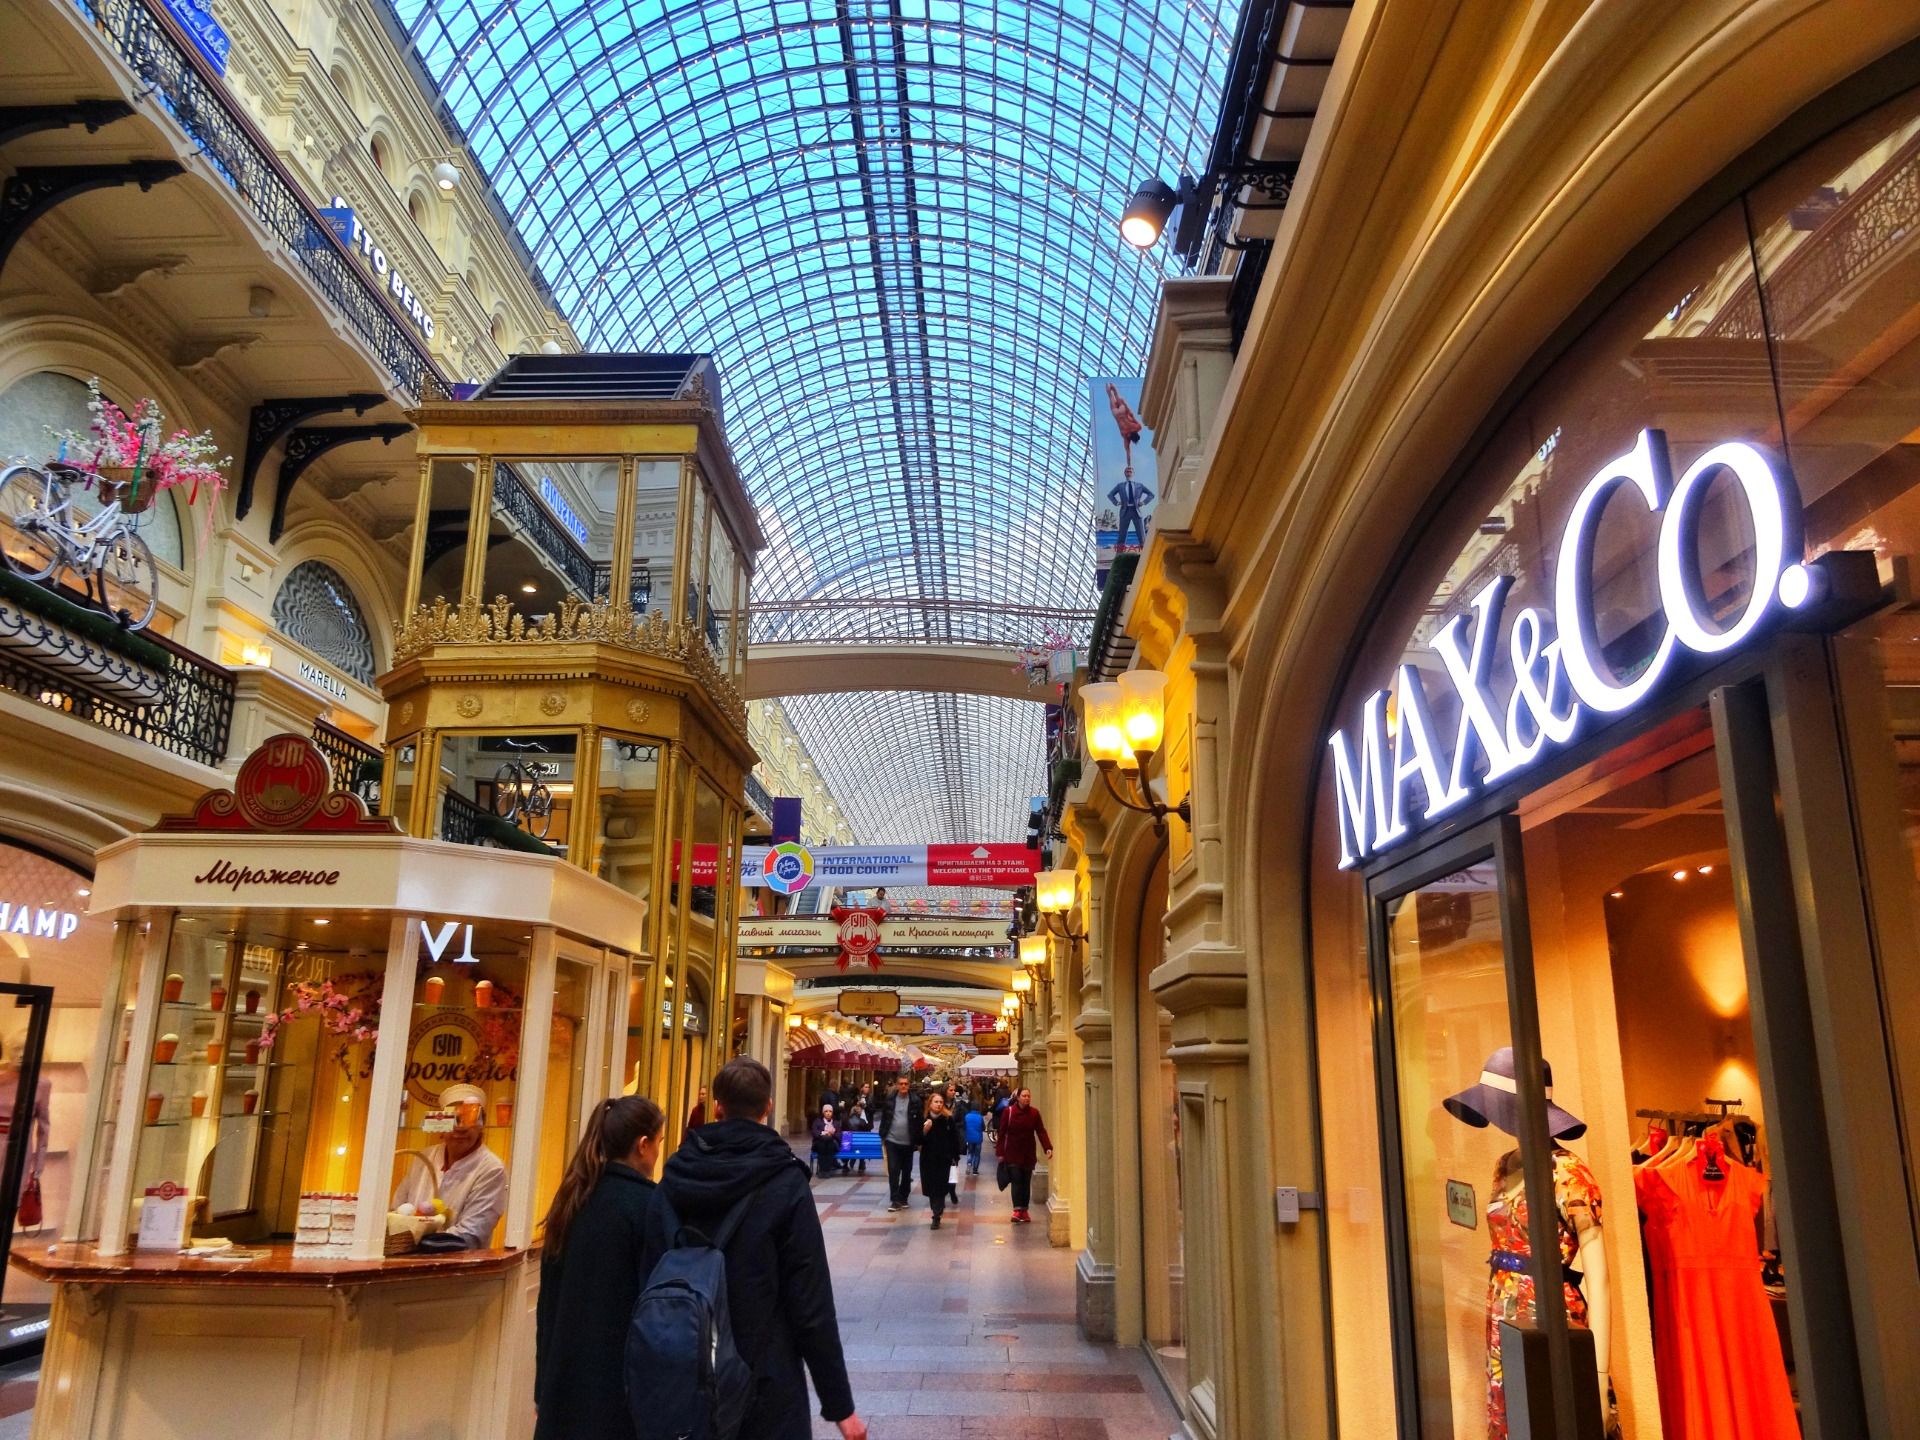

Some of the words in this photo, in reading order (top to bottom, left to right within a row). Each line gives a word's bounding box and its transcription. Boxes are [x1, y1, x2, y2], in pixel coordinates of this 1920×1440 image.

[388, 269, 434, 339] BERG
[1328, 427, 1809, 870] MAX&CO.
[299, 660, 347, 701] MARELLA
[823, 856, 913, 865] INTERNATIONAL
[194, 859, 340, 892] Мороженое
[823, 866, 853, 875] FOOD
[857, 866, 899, 875] COURT!
[851, 914, 868, 927] ГУМ
[778, 929, 822, 937] магазин
[908, 926, 949, 940] Красной
[952, 929, 994, 940] площади
[432, 1033, 462, 1057] ГУМ
